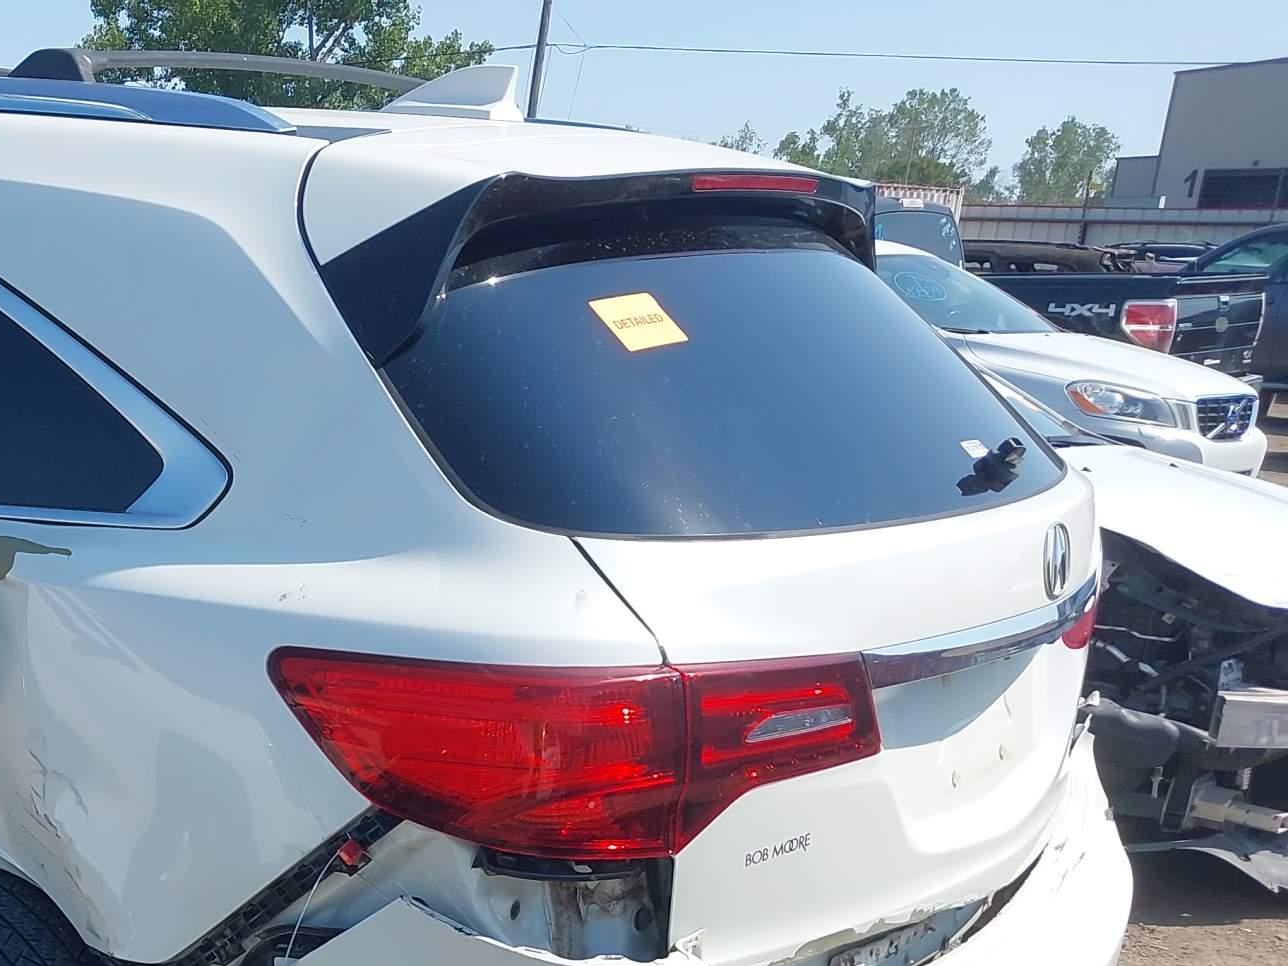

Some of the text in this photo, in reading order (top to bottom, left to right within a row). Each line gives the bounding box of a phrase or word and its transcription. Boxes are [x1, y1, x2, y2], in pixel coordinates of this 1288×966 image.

[1183, 168, 1198, 198] 1
[612, 313, 664, 330] DETAILED
[744, 832, 811, 867] BOB MOORE
